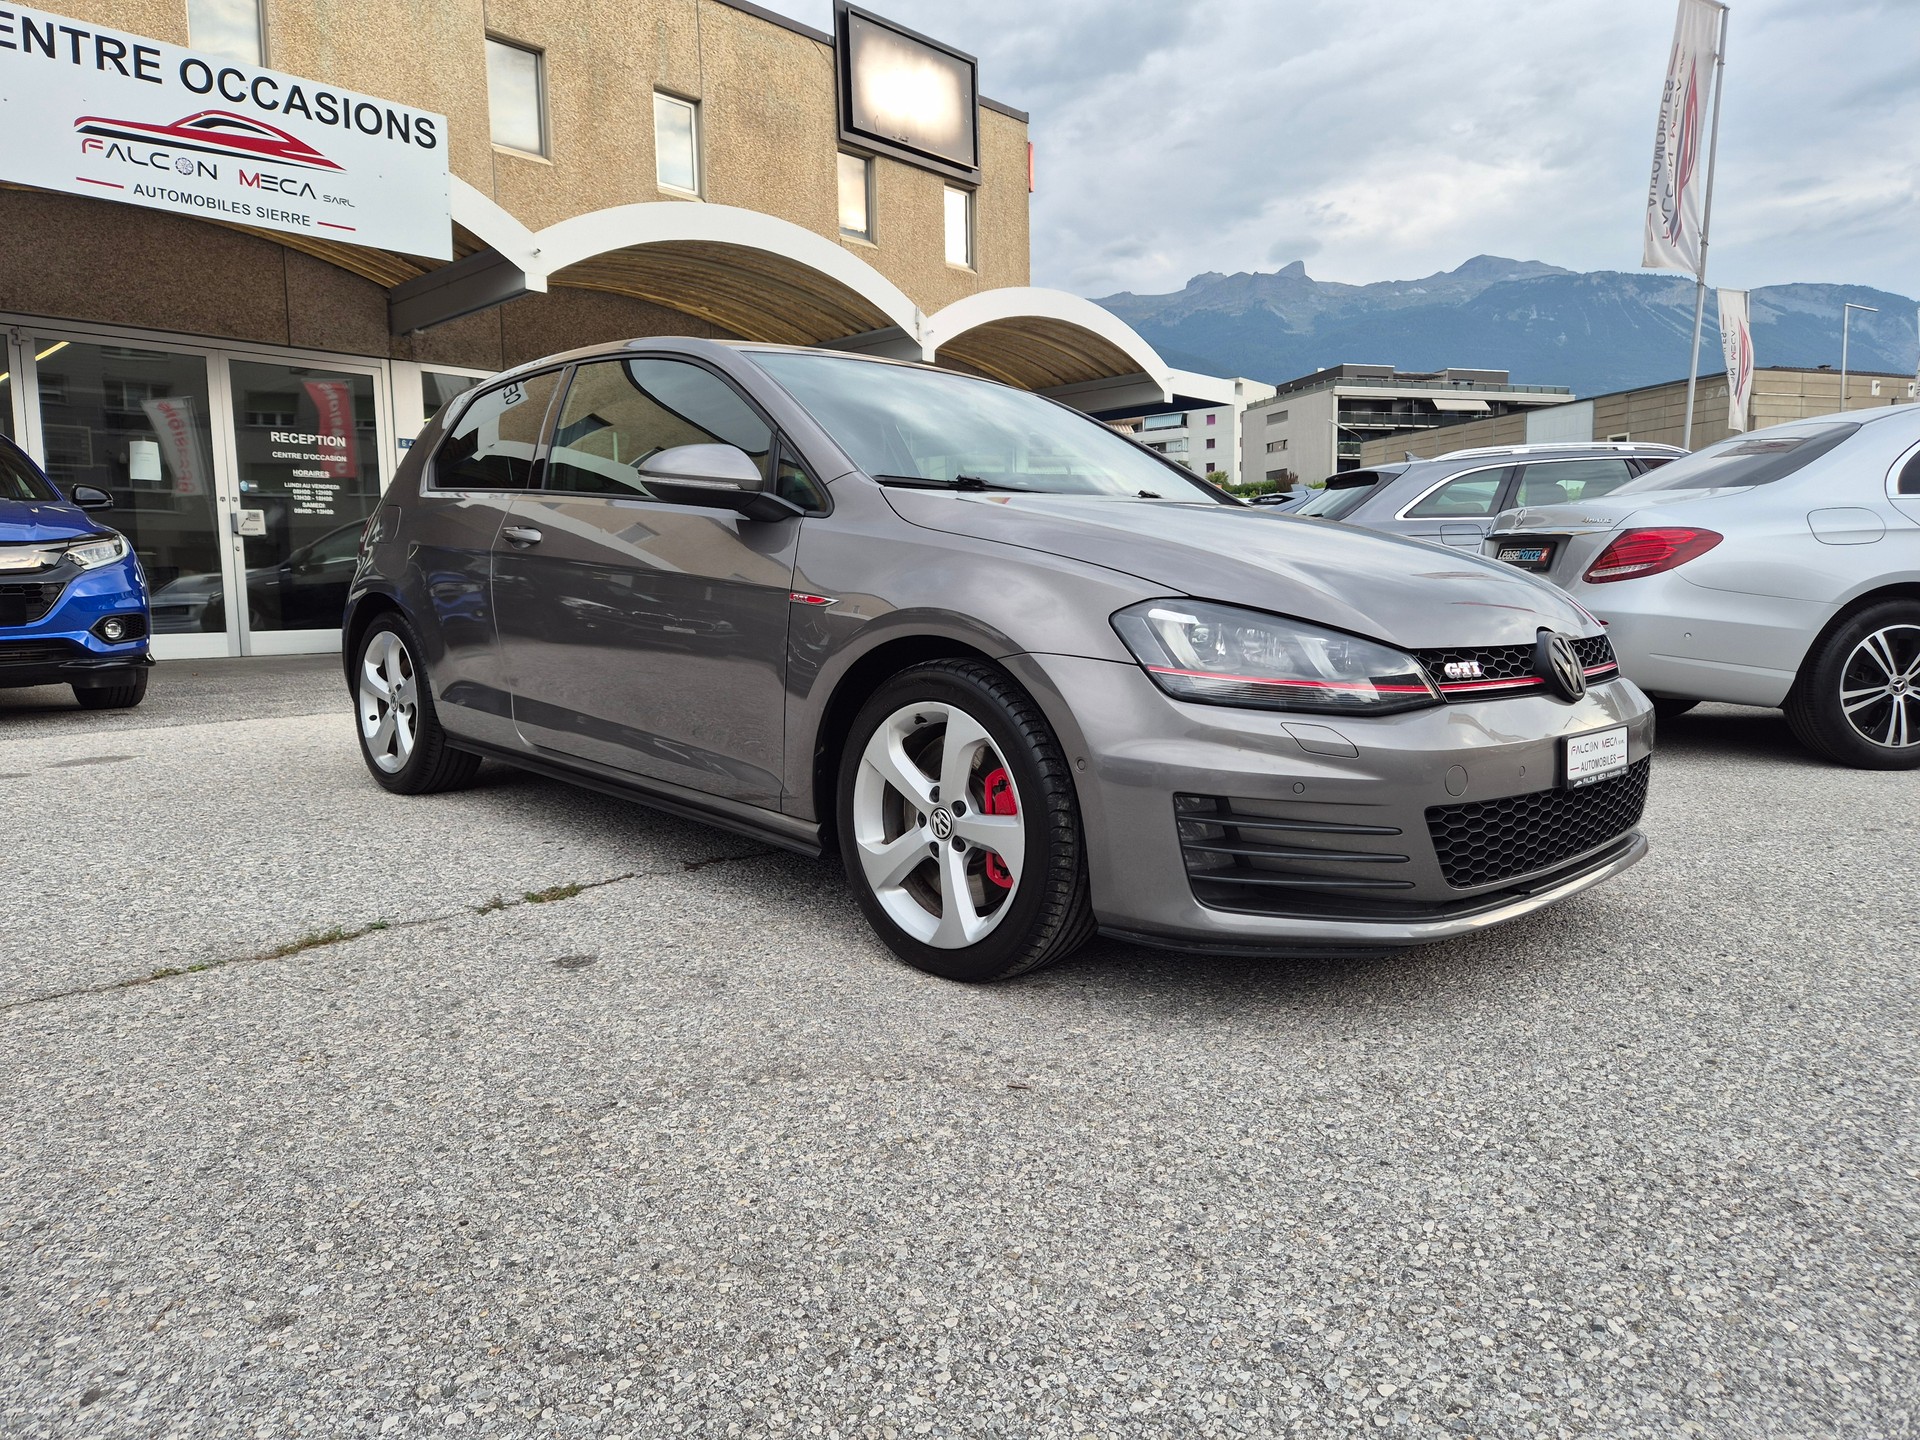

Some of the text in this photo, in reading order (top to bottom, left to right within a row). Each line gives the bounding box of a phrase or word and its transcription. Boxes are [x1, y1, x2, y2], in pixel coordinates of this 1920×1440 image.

[179, 58, 437, 149] OCCASIONS
[82, 138, 356, 208] FALCON MECA SARL
[133, 183, 311, 227] AUTOMOBILES SIERRE
[270, 431, 346, 447] RECEPTION
[272, 451, 347, 462] CENTRE D'OCCASION
[292, 469, 330, 478] HORAIRES
[1498, 549, 1541, 561] LeaseForce
[1444, 661, 1483, 679] GTI
[1580, 754, 1617, 772] AUTOMOBILES
